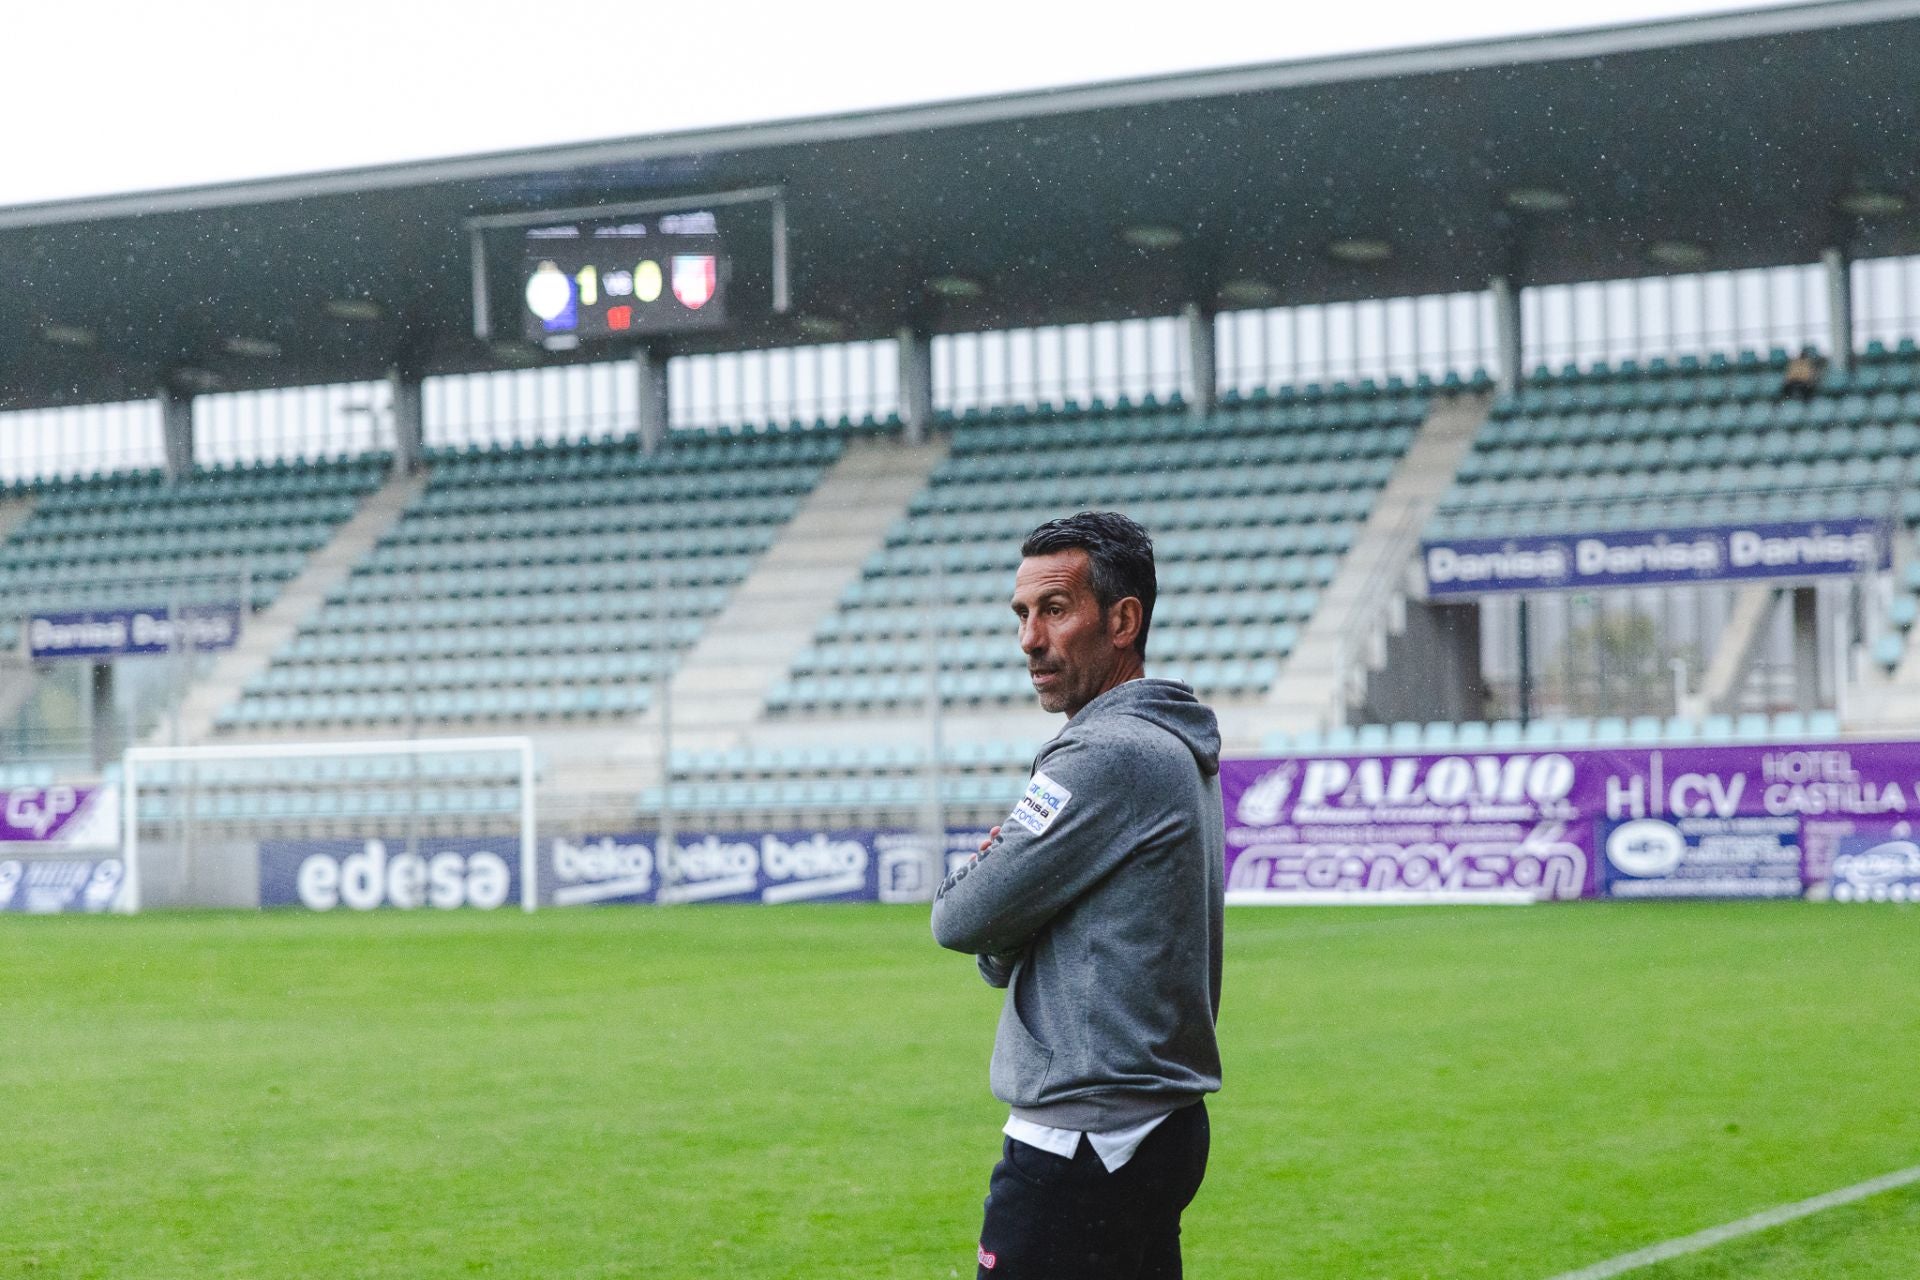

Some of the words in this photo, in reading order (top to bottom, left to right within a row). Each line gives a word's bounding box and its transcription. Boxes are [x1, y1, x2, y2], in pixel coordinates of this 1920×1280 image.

[576, 264, 597, 305] 1
[634, 260, 662, 303] 0
[1428, 544, 1566, 582] Danisa
[1576, 536, 1719, 575] Danisa
[1300, 753, 1576, 808] PALOMO
[1761, 750, 1860, 783] HOTEL
[1763, 782, 1908, 815] CASTILLA
[297, 840, 512, 912] edesa
[553, 836, 654, 883] beko
[762, 833, 869, 882] beko
